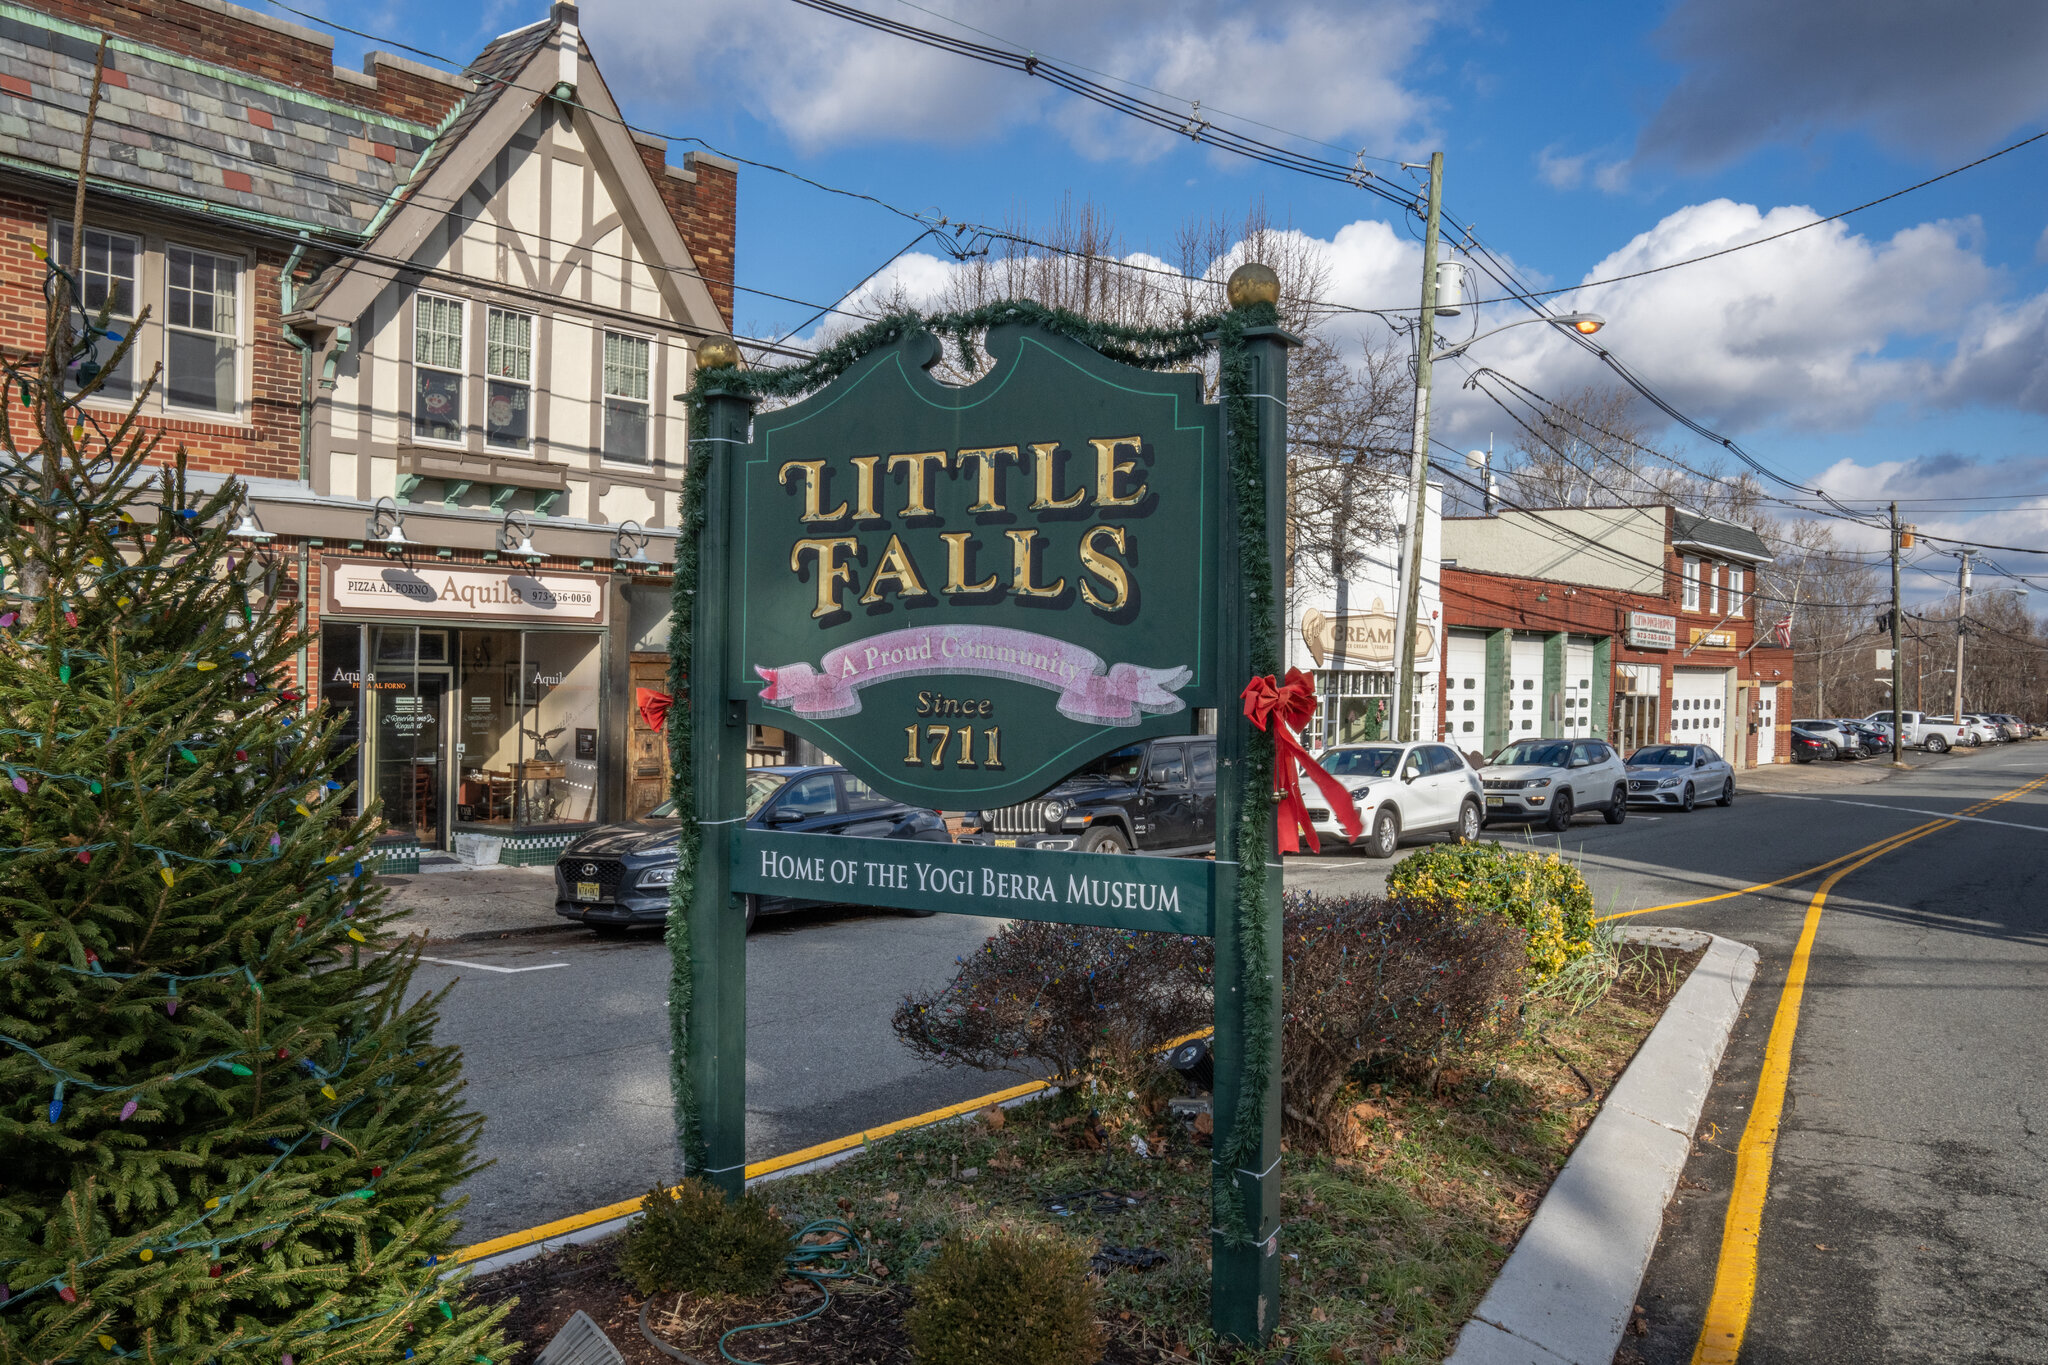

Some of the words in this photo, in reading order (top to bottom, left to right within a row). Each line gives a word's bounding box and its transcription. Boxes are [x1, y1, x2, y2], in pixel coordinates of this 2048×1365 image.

[778, 436, 1149, 523] LITTLE
[347, 580, 376, 592] PIZZA
[379, 582, 393, 593] AL
[395, 583, 429, 595] FORNO
[790, 526, 1130, 619] FALLS
[437, 575, 523, 609] Aquila
[1331, 624, 1423, 645] CREAMY
[332, 667, 374, 684] Aqua
[841, 654, 858, 680] A
[866, 636, 932, 670] Proud
[941, 635, 1082, 683] Community
[533, 671, 567, 687] Aquila
[916, 690, 991, 715] Since
[903, 724, 1003, 767] 1711
[760, 850, 825, 882] HOME
[830, 858, 858, 885] OF
[863, 863, 908, 890] THE
[914, 862, 974, 896] YOGI
[981, 867, 1057, 902] BERRA
[1066, 873, 1182, 913] MUSEUM
